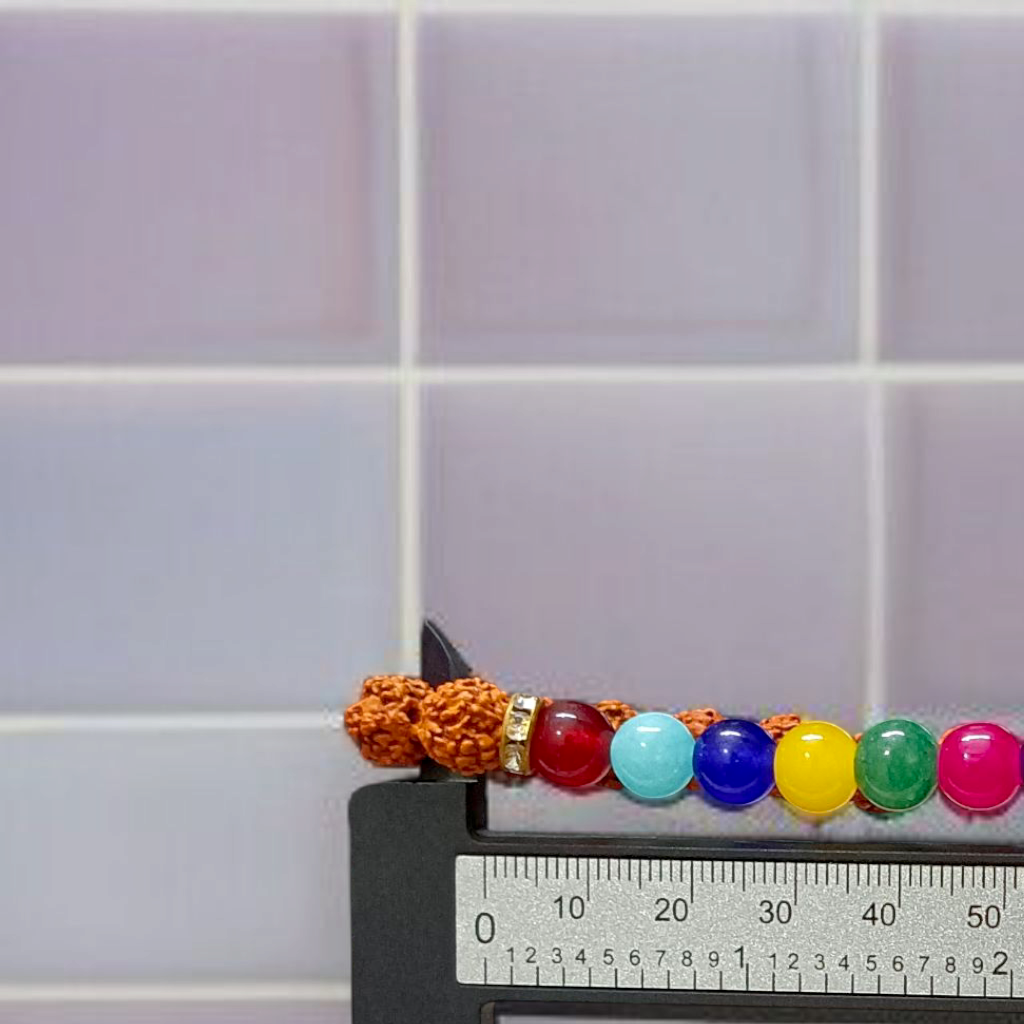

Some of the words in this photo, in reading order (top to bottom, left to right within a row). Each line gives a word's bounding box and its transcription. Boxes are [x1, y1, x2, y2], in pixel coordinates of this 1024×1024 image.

[475, 913, 495, 943] 0
[555, 897, 585, 919] 10
[655, 899, 688, 922] 20
[759, 901, 792, 924] 30
[862, 904, 896, 926] 40
[967, 906, 1000, 928] 50
[506, 948, 515, 962] 1
[526, 948, 536, 963] 2
[552, 949, 562, 964] 3
[575, 949, 586, 964] 4
[603, 949, 614, 965] 5
[629, 950, 640, 965] 6
[656, 951, 666, 966] 7
[682, 951, 693, 966] 8
[708, 952, 719, 967] 9
[735, 947, 746, 968] 1
[769, 954, 778, 969] 1
[788, 954, 799, 969] 2
[814, 955, 825, 970] 3
[838, 955, 850, 970] 4
[866, 956, 877, 971] 5
[893, 956, 904, 972] 6
[919, 957, 930, 972] 7
[945, 957, 956, 973] 8
[972, 958, 984, 973] 9
[992, 952, 1008, 975] 2
